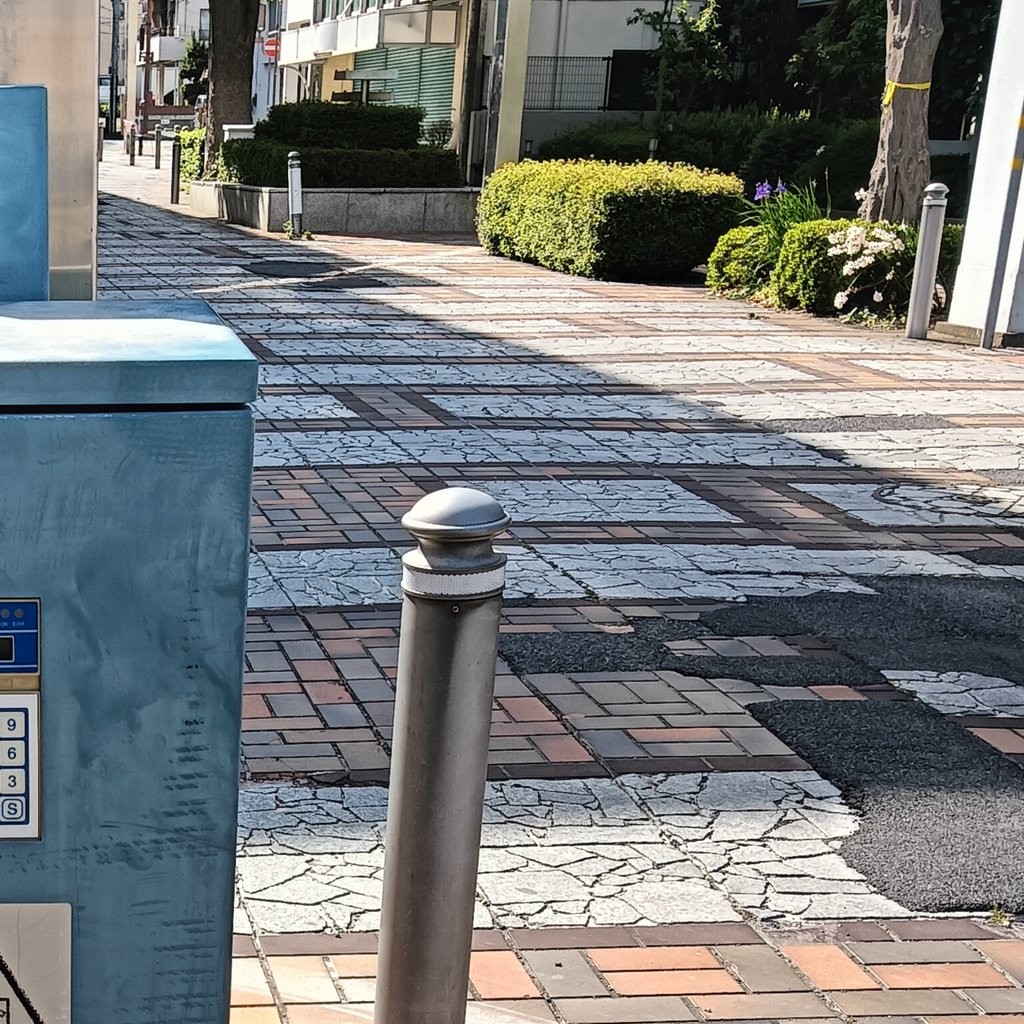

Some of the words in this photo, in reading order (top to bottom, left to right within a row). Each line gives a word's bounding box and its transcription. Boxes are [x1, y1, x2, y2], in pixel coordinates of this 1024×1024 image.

[6, 718, 17, 731] 9
[7, 746, 17, 760] 6
[7, 775, 17, 788] 3
[7, 802, 18, 816] S
